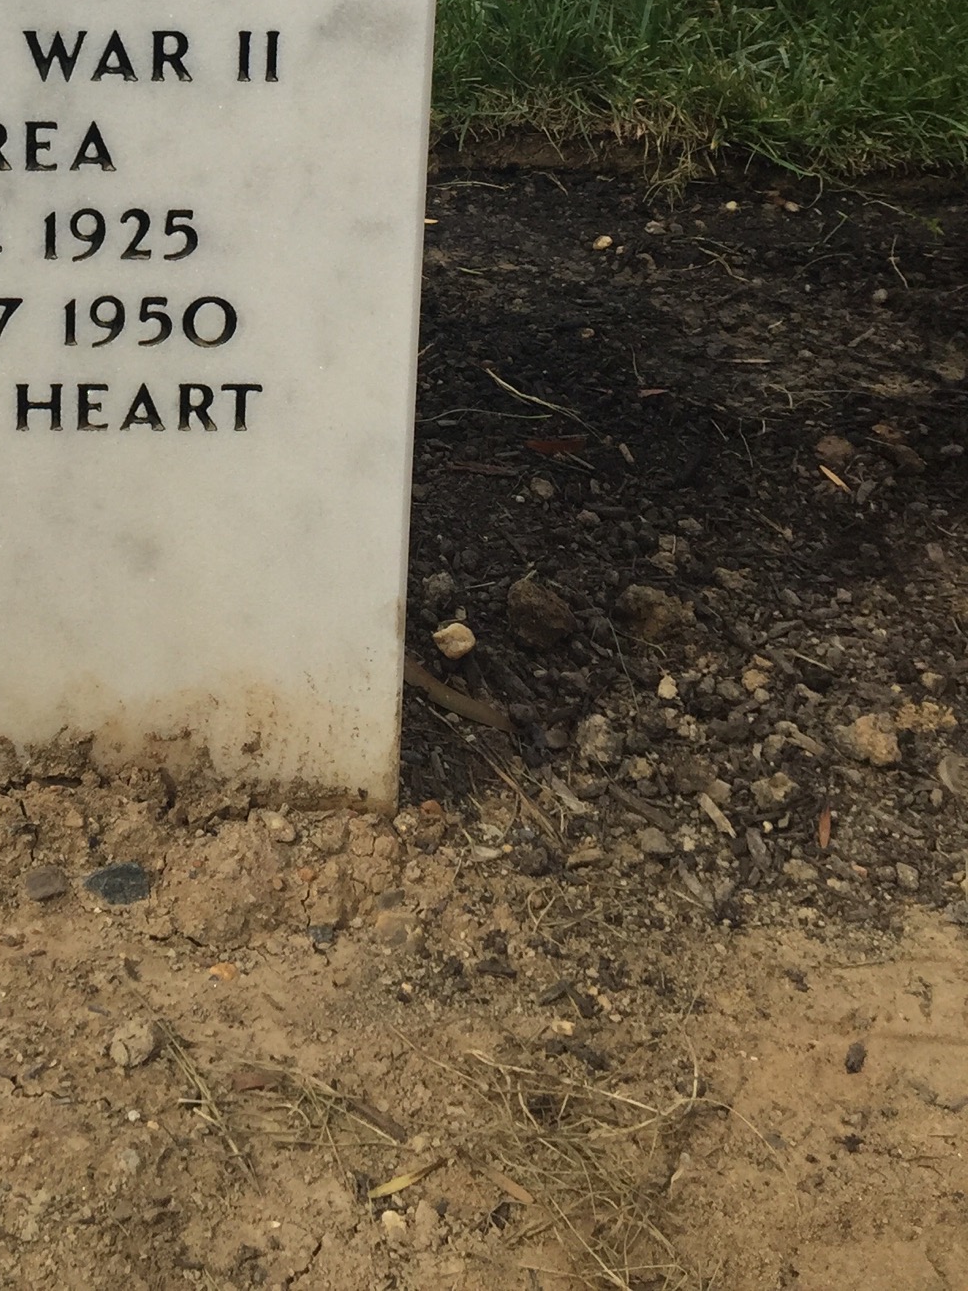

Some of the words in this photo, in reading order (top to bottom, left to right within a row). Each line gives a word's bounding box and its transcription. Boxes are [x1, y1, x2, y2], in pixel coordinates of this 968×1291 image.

[23, 30, 193, 82] WAR
[237, 31, 280, 82] II
[44, 208, 198, 262] 1925
[64, 295, 237, 348] 1950
[16, 383, 262, 431] HEART
